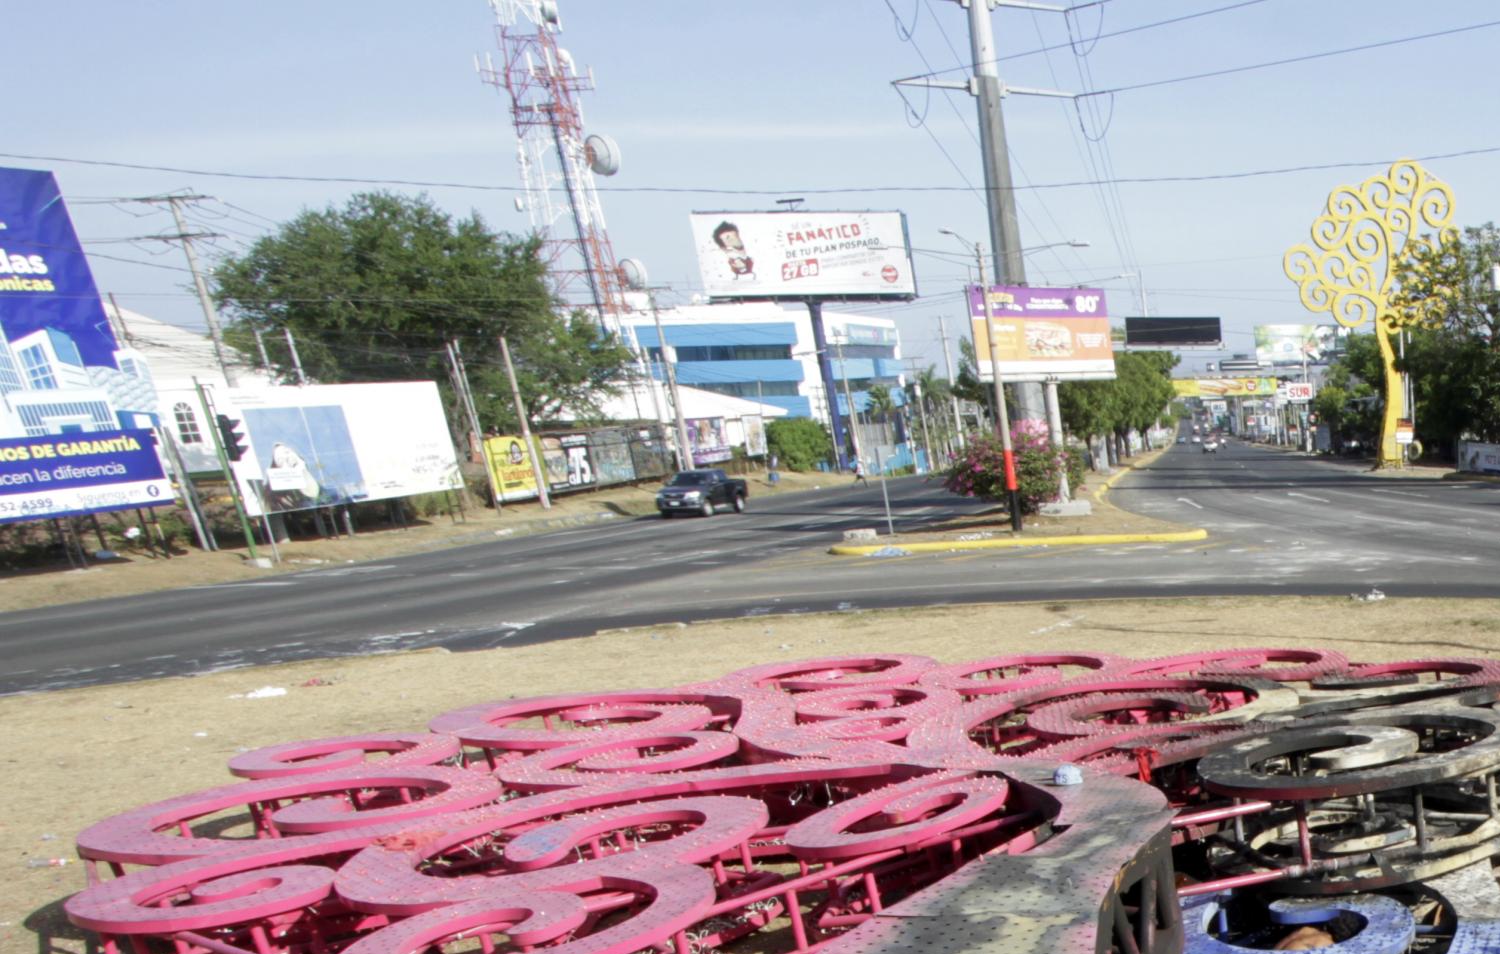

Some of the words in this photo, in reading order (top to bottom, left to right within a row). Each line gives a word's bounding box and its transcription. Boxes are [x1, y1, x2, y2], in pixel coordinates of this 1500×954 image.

[786, 249, 797, 259] DE
[799, 247, 812, 257] TU
[813, 243, 838, 255] PLAN
[839, 236, 881, 251] POSPAGO
[1289, 387, 1310, 398] SUR
[30, 443, 56, 459] DE
[57, 435, 141, 457] GARANTÍA
[34, 468, 51, 482] la
[52, 461, 127, 481] diferencia
